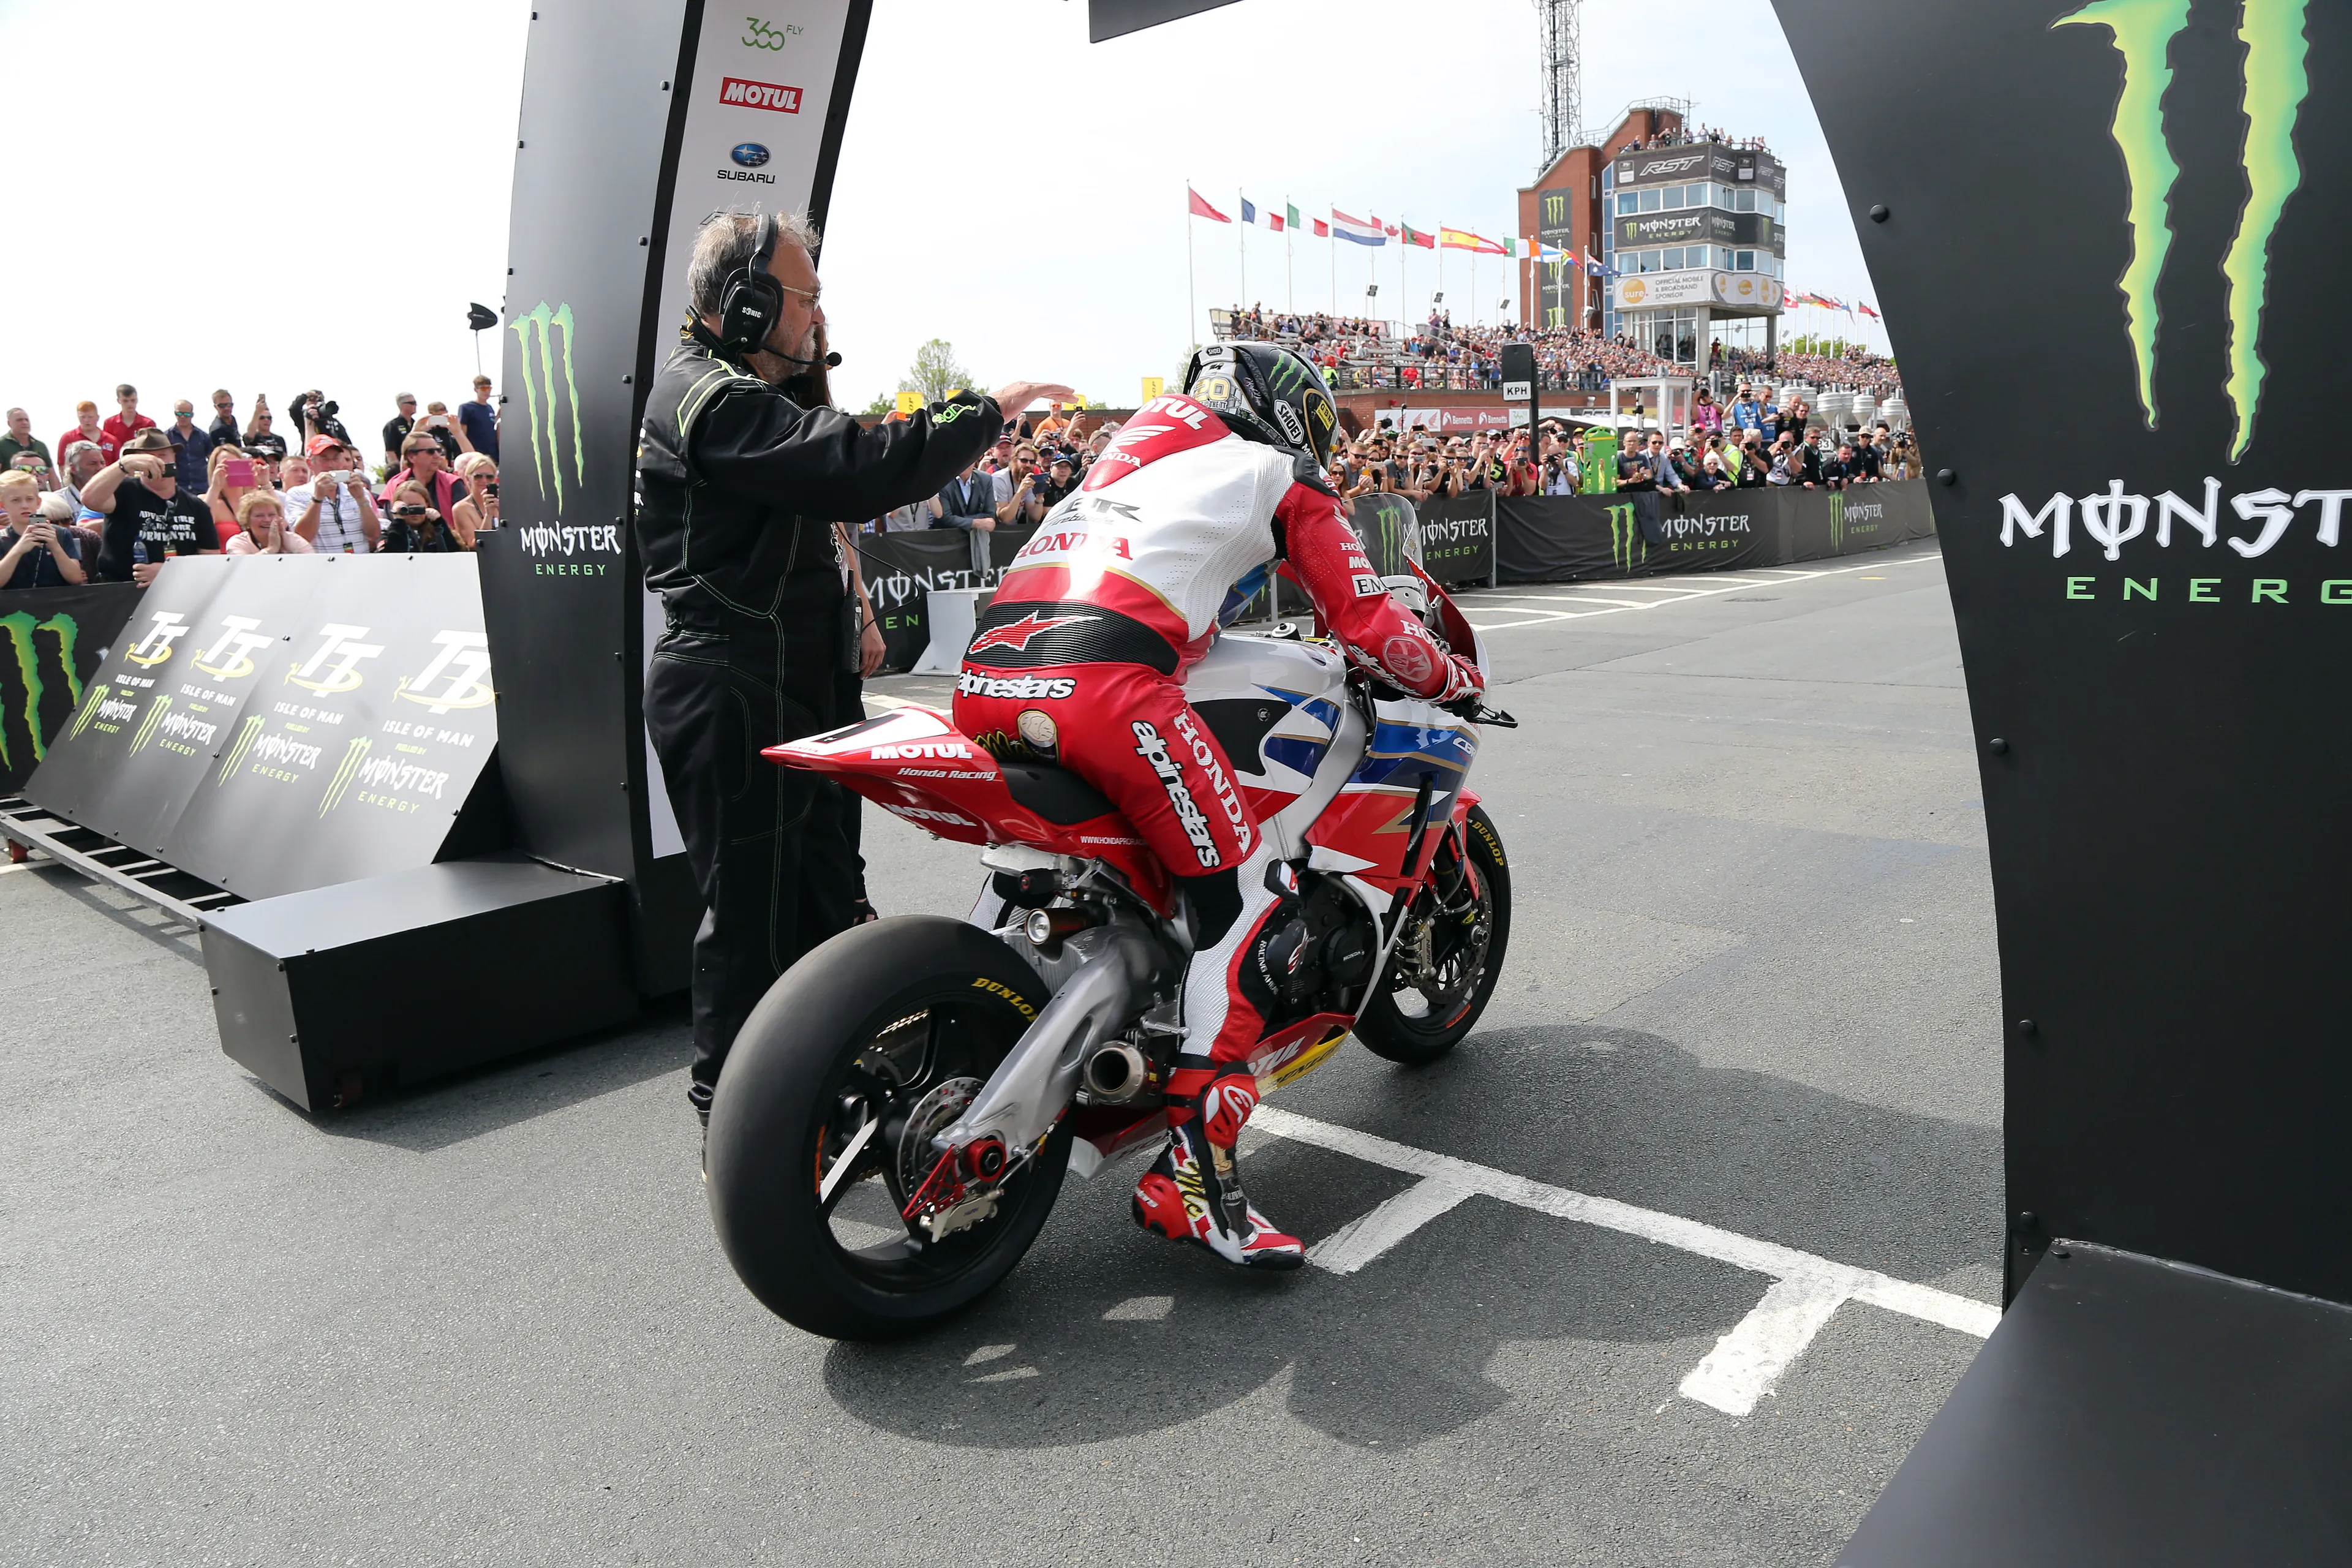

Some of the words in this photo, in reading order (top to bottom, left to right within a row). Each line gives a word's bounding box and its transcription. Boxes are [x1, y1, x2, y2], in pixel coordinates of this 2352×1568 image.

[742, 17, 785, 51] 360
[786, 24, 804, 36] FLY
[723, 82, 797, 110] MOTUL
[1640, 155, 1705, 176] RST
[1711, 156, 1735, 172] RST
[717, 170, 775, 184] SUBARU
[1639, 216, 1701, 232] MONSTER
[1648, 230, 1692, 239] ENERGY
[1711, 216, 1735, 231] MONSTER
[1660, 284, 1697, 292] BROADBAND
[1507, 386, 1527, 396] KPH
[1278, 405, 1302, 439] SHOEI
[1452, 415, 1473, 424] Bennetts
[1488, 415, 1507, 424] Bennetts
[1844, 502, 1883, 523] MONSTER
[520, 520, 622, 558] MONSTER
[1851, 524, 1879, 533] ENERGY
[1427, 545, 1479, 560] ENERGY
[1671, 539, 1738, 551] ENERGY
[535, 564, 606, 576] ENERGY
[134, 611, 190, 669] TT
[201, 614, 274, 682] TT
[296, 622, 386, 698] TT
[115, 674, 130, 685] ISLE
[130, 676, 141, 687] OF
[141, 678, 156, 688] MAN
[958, 669, 1076, 698] alpinestars
[180, 684, 200, 699] ISLE
[201, 689, 216, 701] OF
[215, 693, 237, 707] MAN
[97, 697, 137, 722] MONSTER
[274, 701, 297, 718] ISLE
[299, 705, 317, 721] OF
[316, 709, 344, 725] MAN
[94, 721, 121, 734] ENERGY
[160, 710, 217, 746] MONSTER
[382, 718, 409, 736] ISLE
[412, 725, 435, 740] OF
[435, 729, 475, 748] MAN
[159, 738, 197, 757] ENERGY
[252, 732, 322, 771] MONSTER
[870, 743, 973, 761] MOTUL
[252, 763, 300, 784] ENERGY
[358, 755, 449, 800] MONSTER
[897, 767, 947, 778] Honda
[948, 770, 997, 782] Racing
[1174, 709, 1252, 858] HONDA
[358, 790, 420, 815] ENERGY
[1131, 721, 1221, 867] alpinestars
[881, 802, 978, 827] MOTUL
[1472, 821, 1504, 865] DUNLOP
[1257, 940, 1268, 973] RACING
[1343, 951, 1361, 961] HONDA
[1248, 1036, 1306, 1076] OTUL
